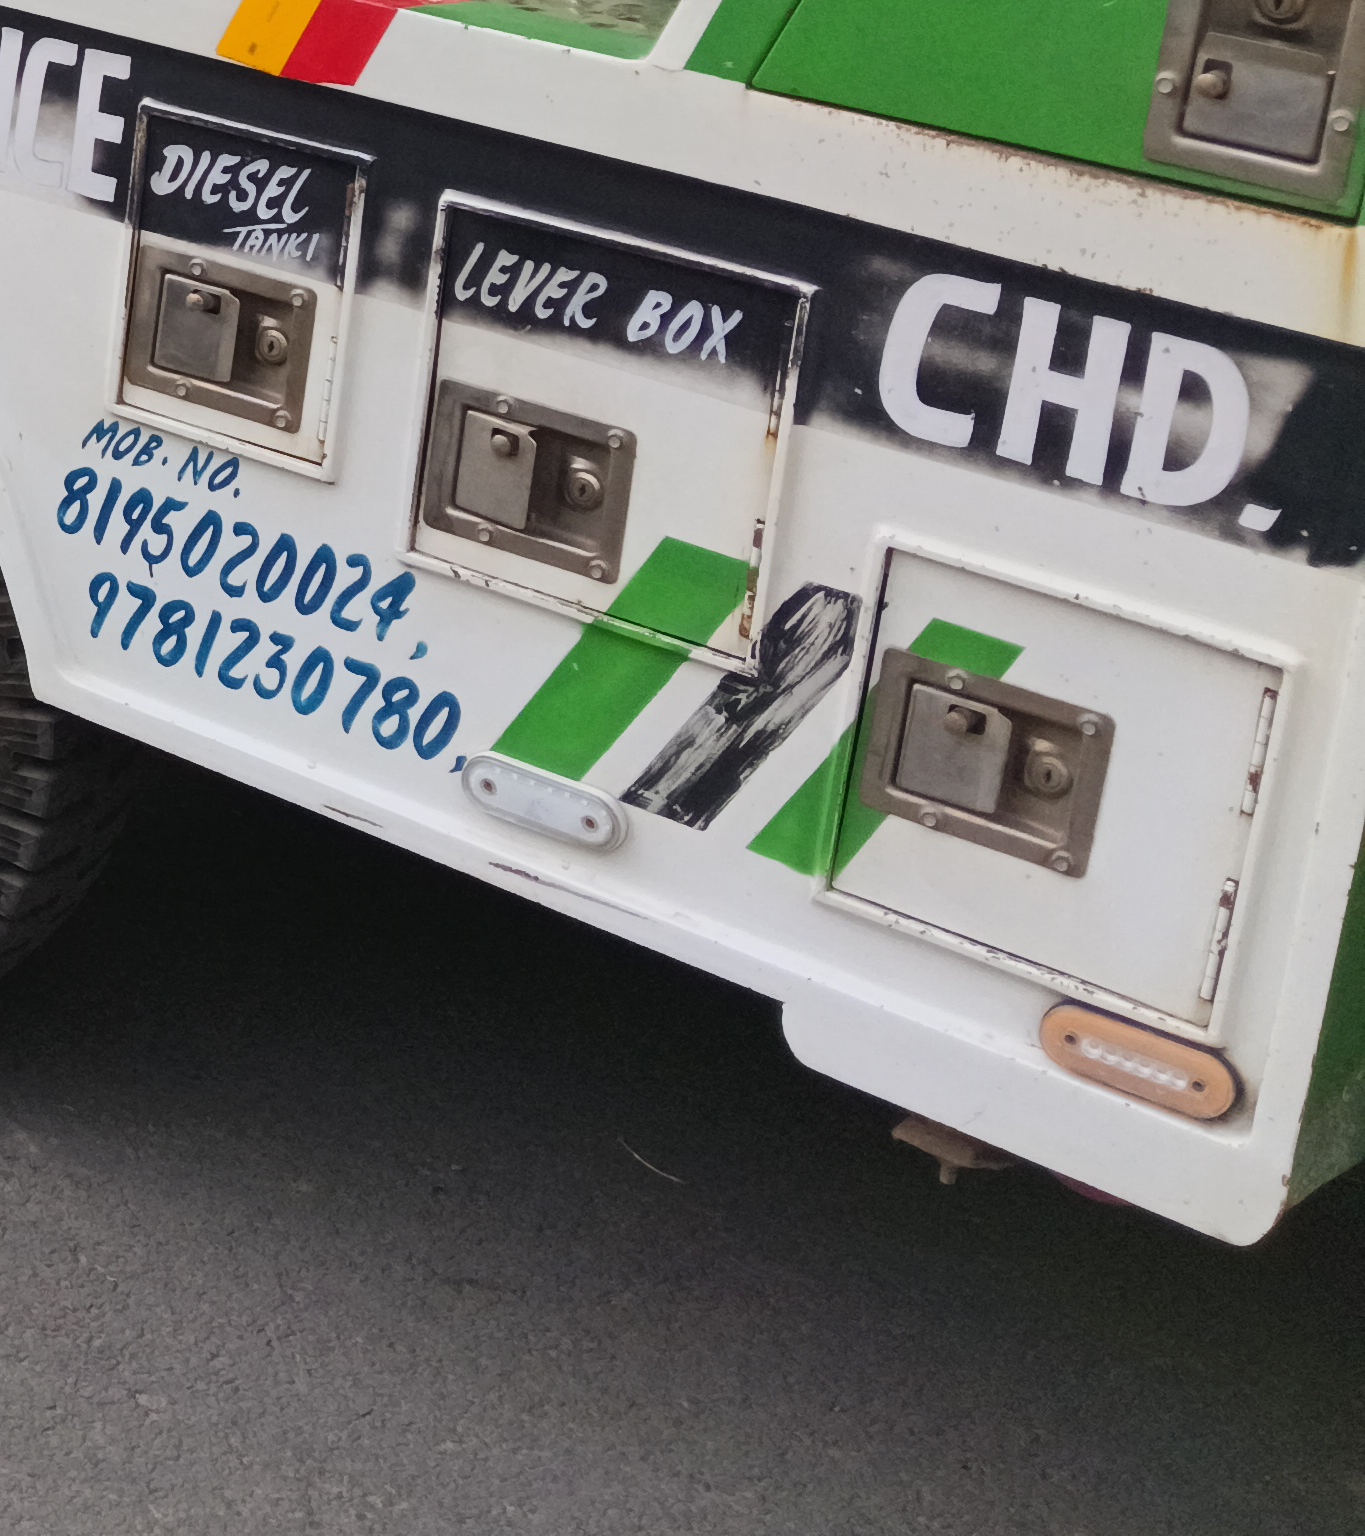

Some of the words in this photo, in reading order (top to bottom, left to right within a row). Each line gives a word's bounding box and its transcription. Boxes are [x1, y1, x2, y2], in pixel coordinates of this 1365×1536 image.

[150, 144, 312, 224] DIESEL
[453, 241, 608, 329] LEVER
[626, 289, 744, 364] BOX
[81, 418, 168, 468] MOB.
[177, 445, 242, 498] NO.
[878, 273, 1282, 532] CHD.
[57, 467, 428, 661] 8195020024,
[88, 570, 468, 774] 9781230780,
